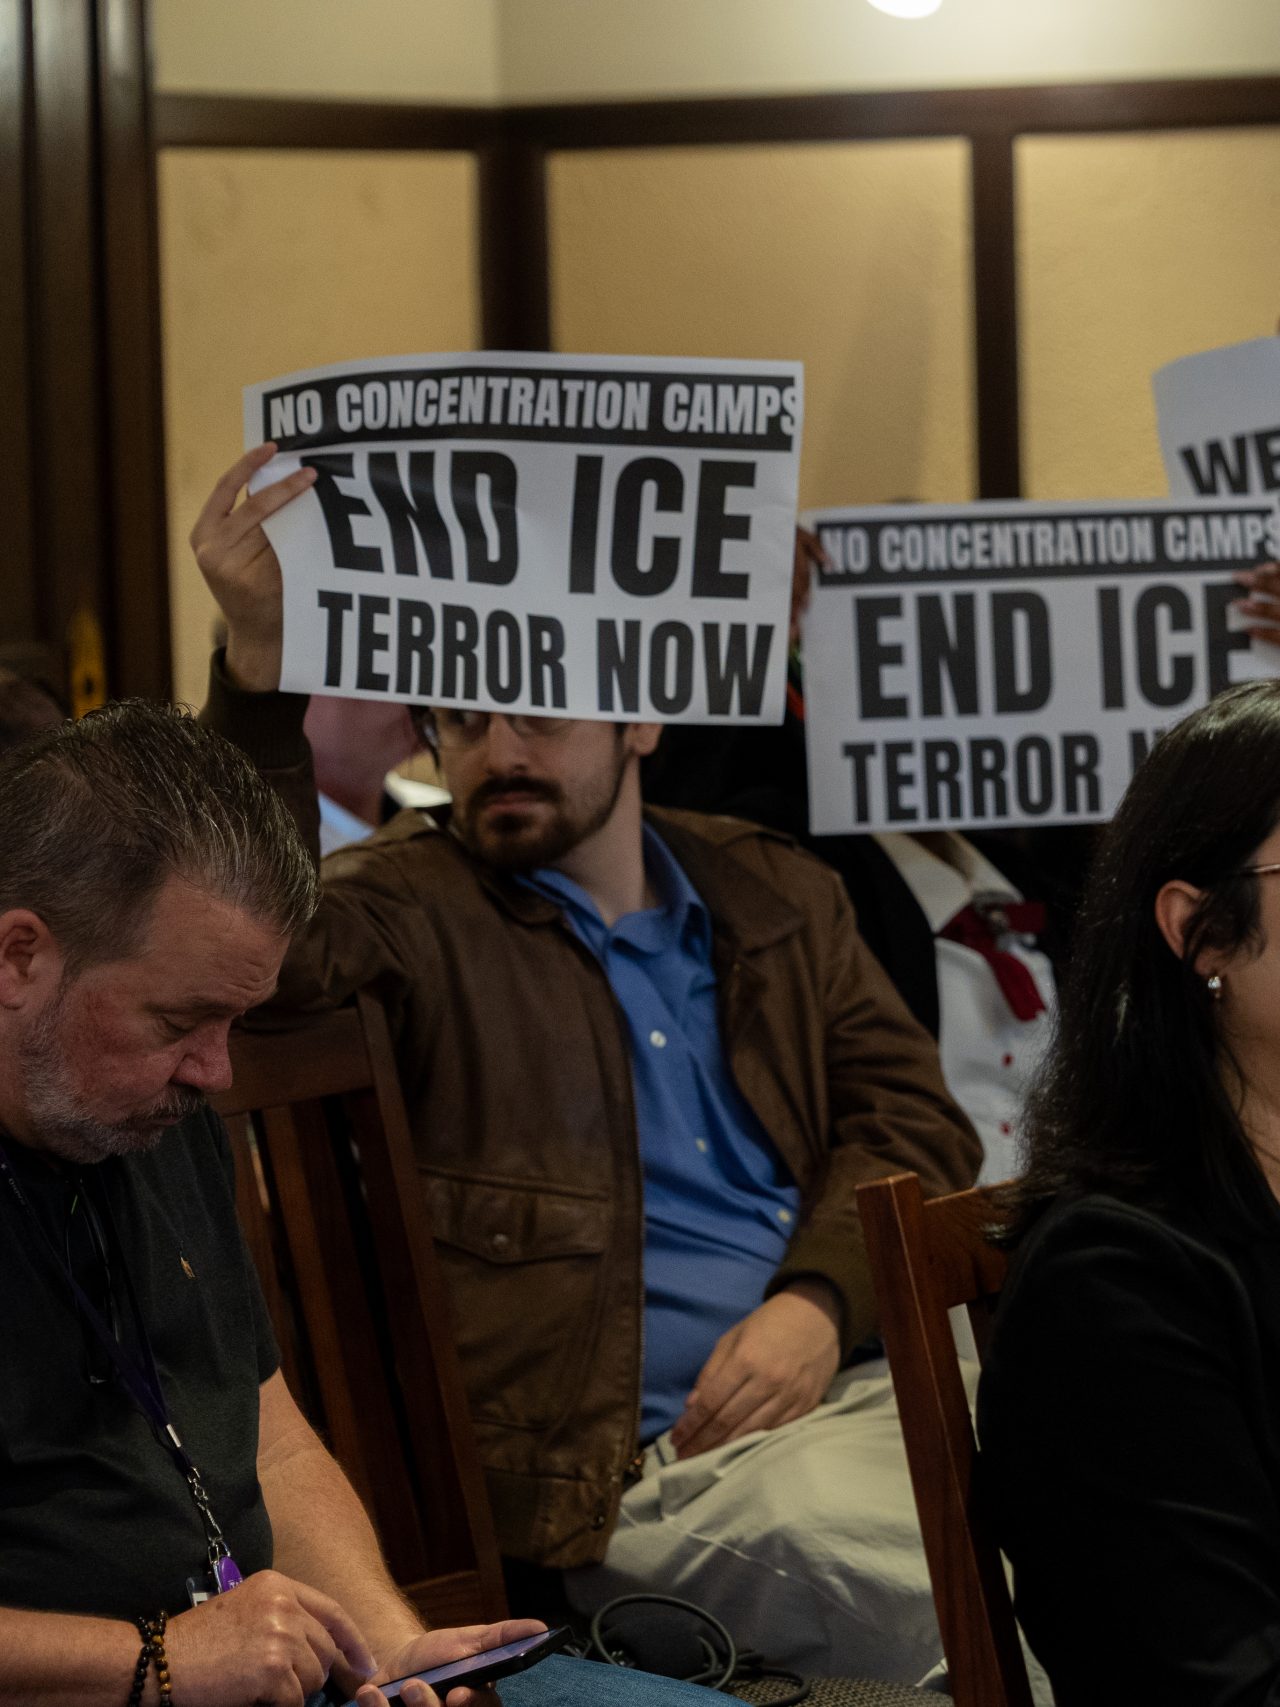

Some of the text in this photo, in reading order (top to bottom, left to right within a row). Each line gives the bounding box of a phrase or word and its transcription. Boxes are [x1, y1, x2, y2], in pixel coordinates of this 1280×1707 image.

[270, 376, 799, 439] NO CONCENTRATION CAMPS
[299, 451, 757, 599] END ICE
[821, 513, 1280, 574] NO CONCENTRATION CAMPS
[317, 590, 774, 717] TERROR NOW
[853, 582, 1253, 721] END ICE
[841, 731, 1101, 824] TERROR
